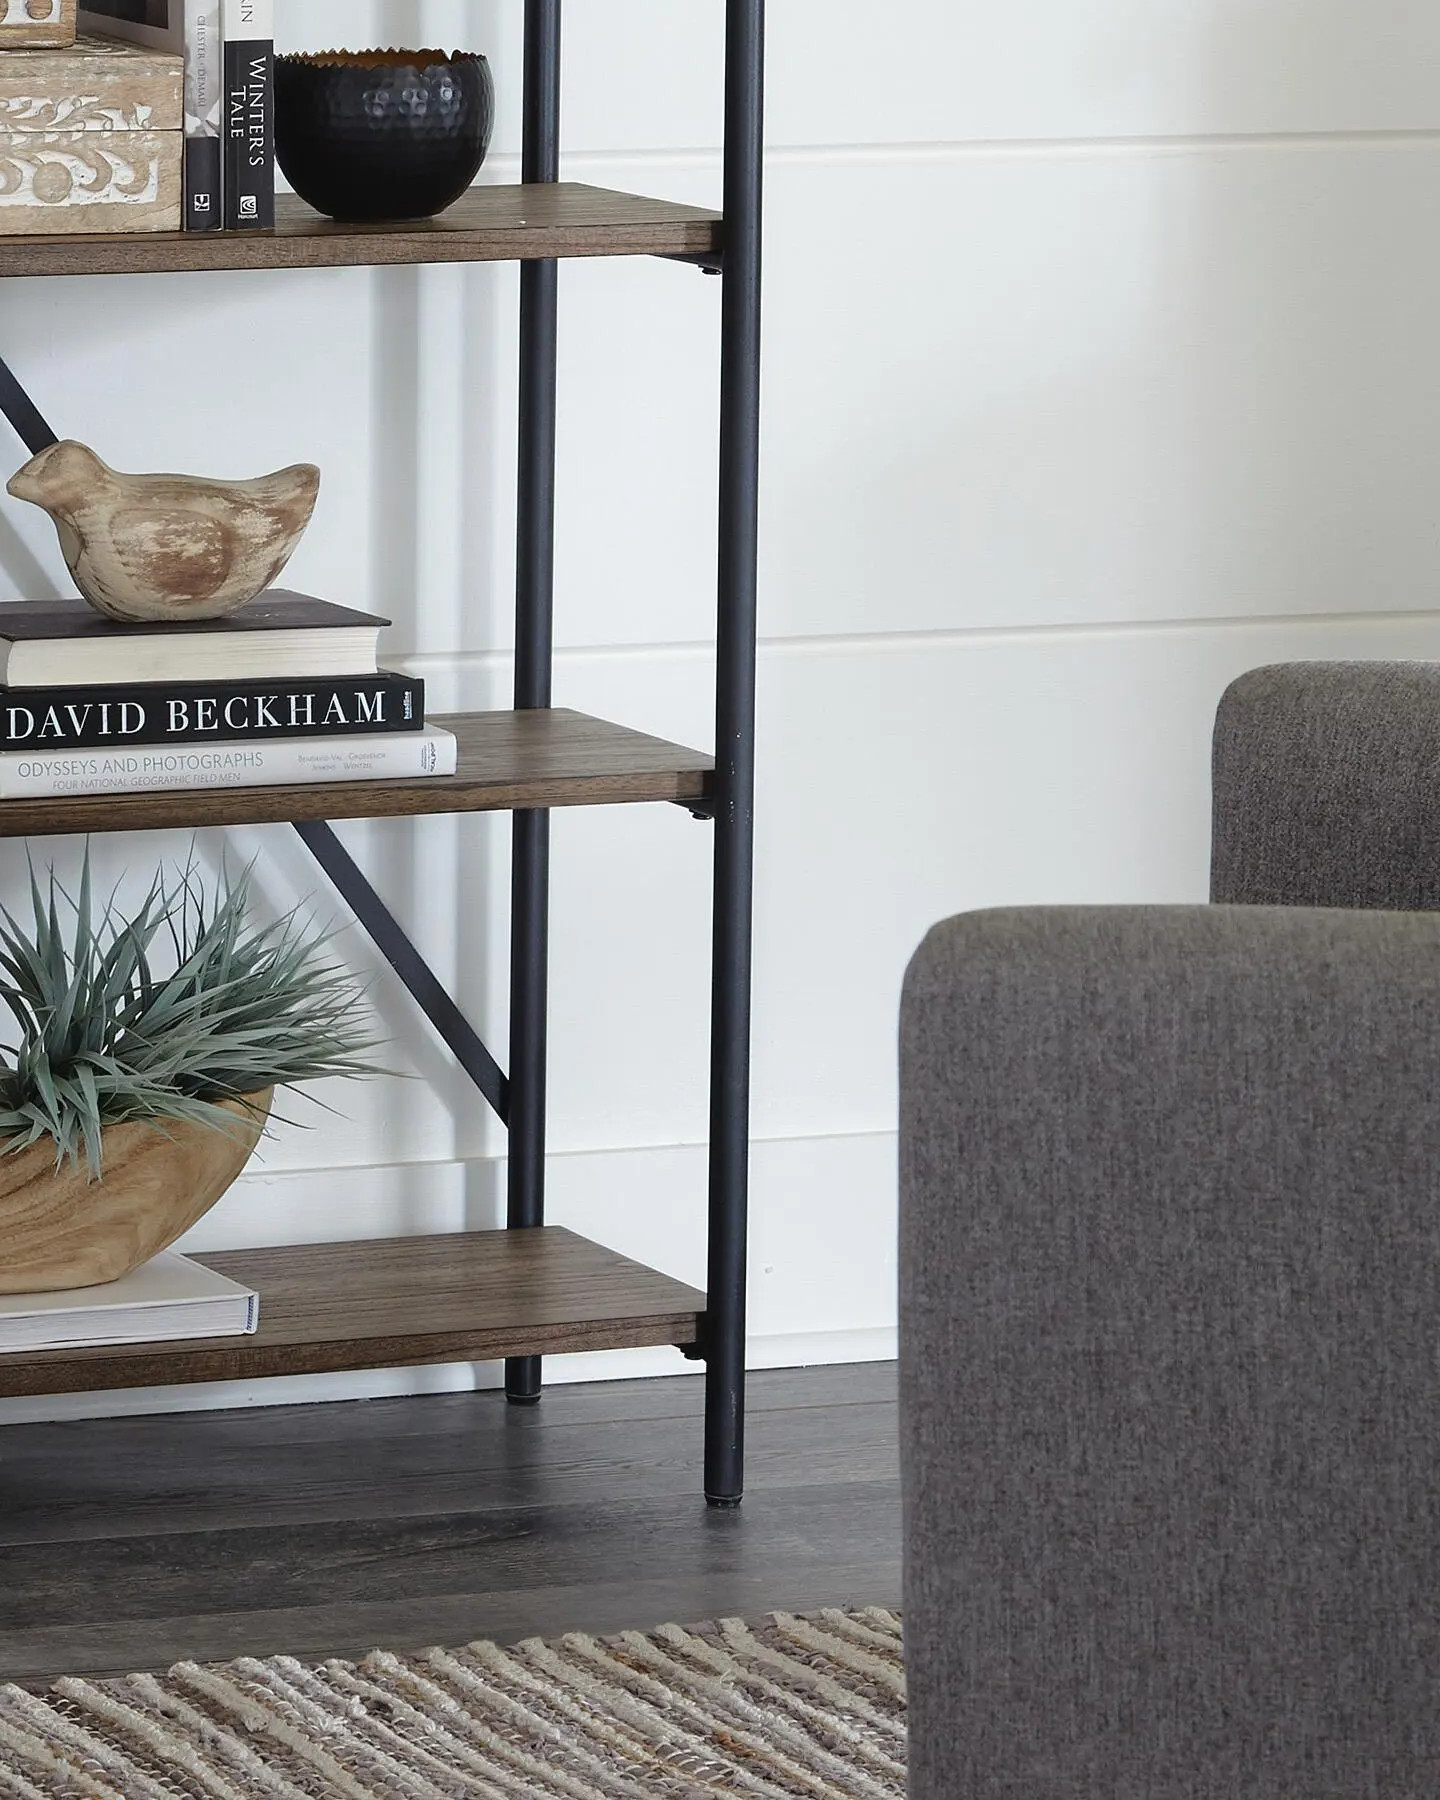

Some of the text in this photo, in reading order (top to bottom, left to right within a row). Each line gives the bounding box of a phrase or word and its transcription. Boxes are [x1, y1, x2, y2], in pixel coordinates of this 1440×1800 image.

[230, 85, 247, 138] TALE
[249, 56, 267, 166] WINTER'S
[6, 691, 387, 740] DAVID BECKHAM
[18, 752, 264, 778] ODYSSEYS AND PHOTOGRAPHS
[53, 772, 241, 790] FOUR NATIONAL GEOGRAPHIC FIELD MEN
